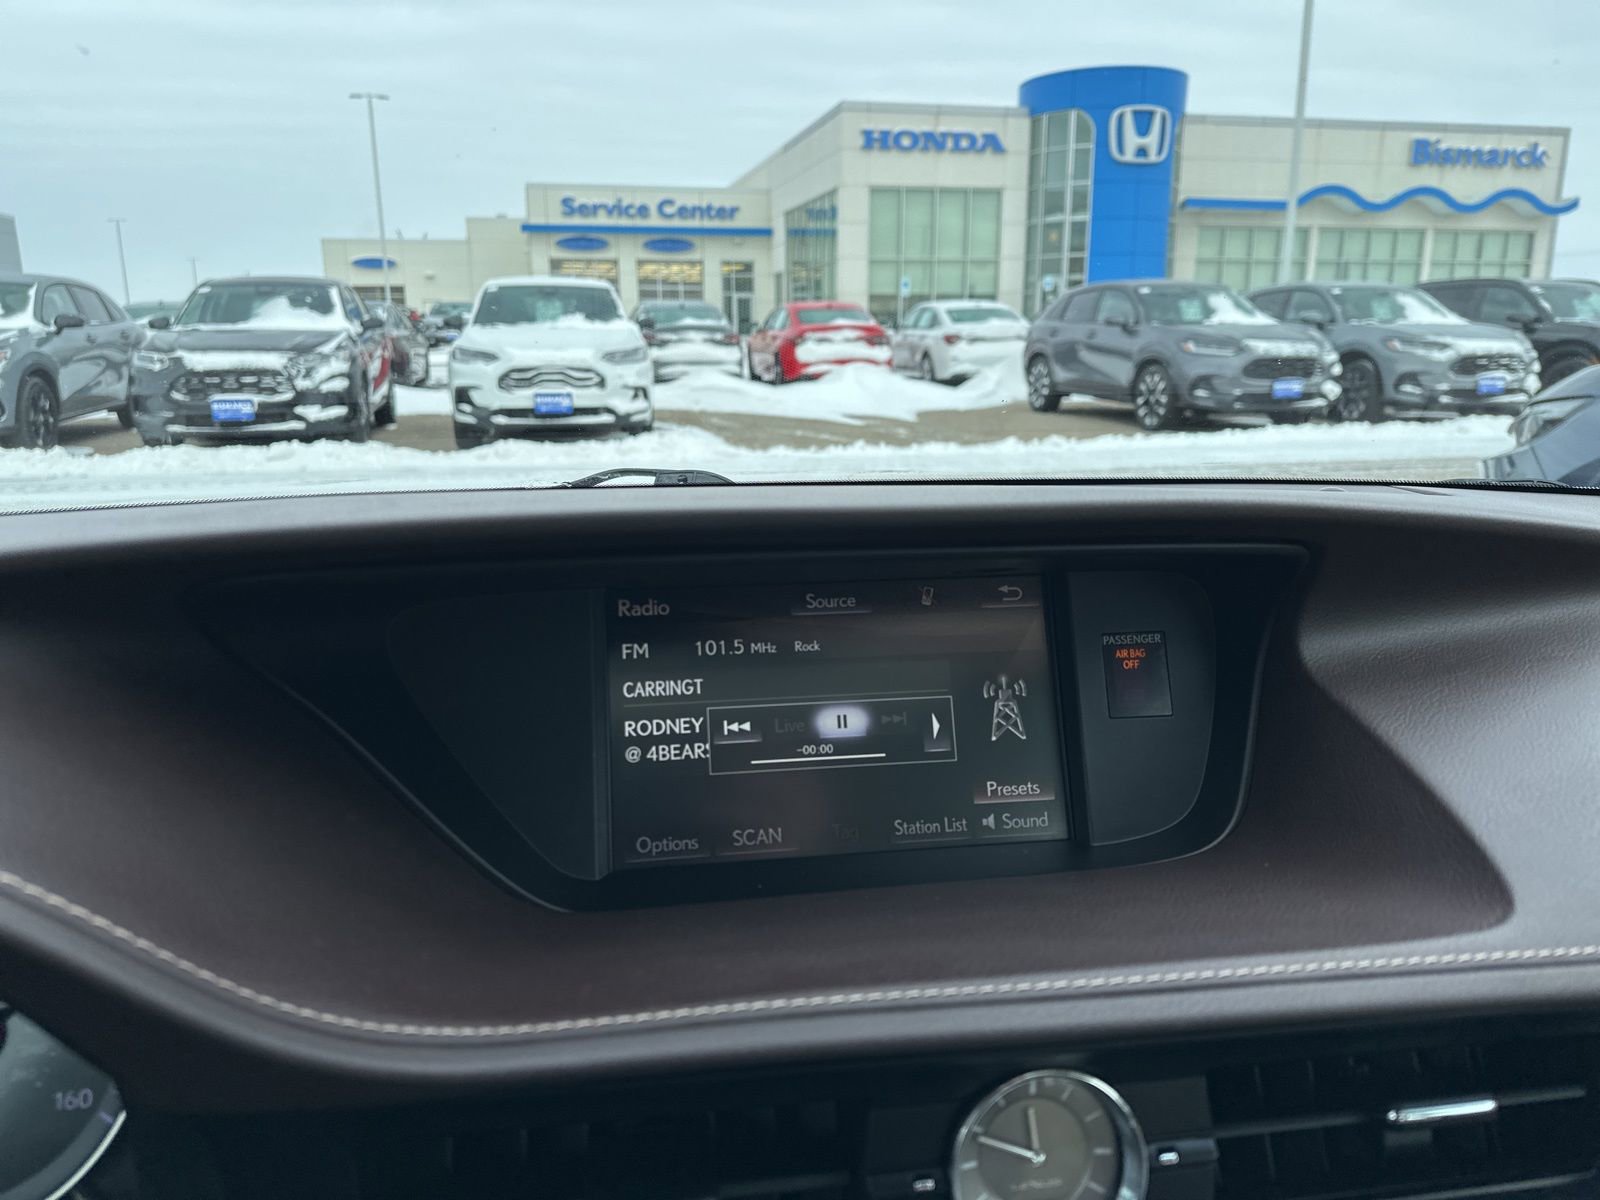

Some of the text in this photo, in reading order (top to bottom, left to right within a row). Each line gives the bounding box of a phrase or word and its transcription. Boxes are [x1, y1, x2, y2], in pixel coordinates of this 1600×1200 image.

[862, 128, 1006, 154] HONDA
[1411, 137, 1549, 168] Bismarck
[561, 197, 740, 219] Service Center
[617, 599, 670, 618] Radio
[805, 594, 857, 610] Source
[621, 638, 821, 660] FM 101.5 MHz Rock
[1103, 633, 1161, 645] PASSENGER
[1123, 660, 1140, 669] OFF
[622, 678, 704, 699] CARRINGT
[623, 716, 704, 738] RODNEY
[624, 746, 642, 764] @
[985, 780, 1041, 798] Presets
[894, 816, 968, 837] Station List
[1001, 811, 1049, 830] Sound
[635, 834, 699, 855] Options
[732, 827, 783, 847] SCAN
[55, 1088, 94, 1111] 160
